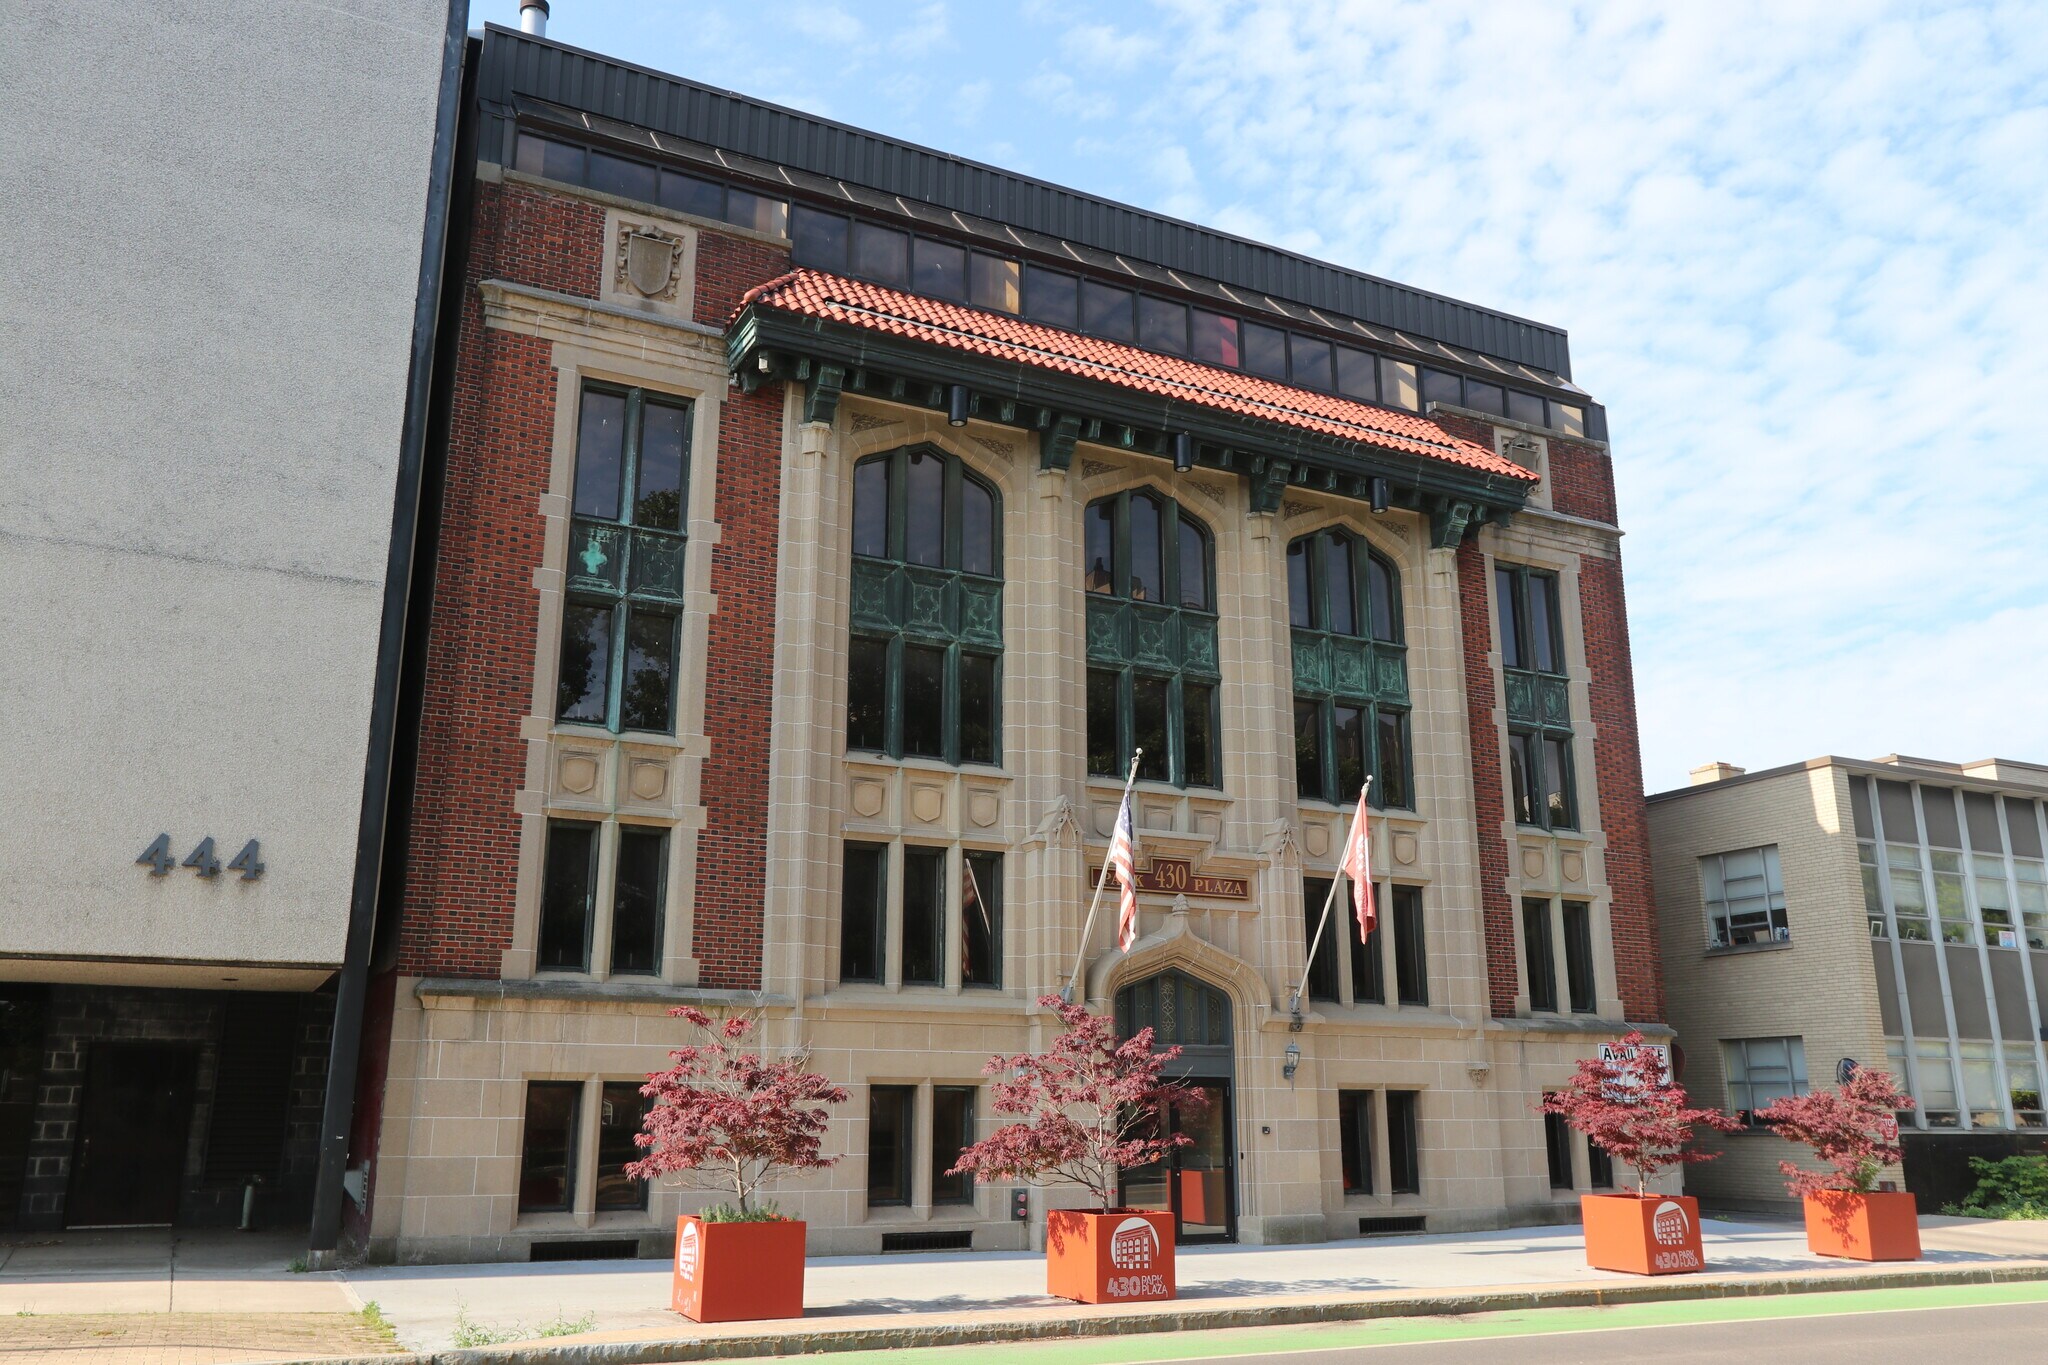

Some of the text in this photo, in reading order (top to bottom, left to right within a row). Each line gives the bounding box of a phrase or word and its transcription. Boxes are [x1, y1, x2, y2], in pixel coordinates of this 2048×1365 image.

[135, 832, 265, 879] 444
[1103, 863, 1244, 895] PAK 430 PLAZA
[1655, 1252, 1679, 1269] 430
[1679, 1250, 1695, 1259] PARK
[1107, 1275, 1140, 1297] 430
[1142, 1275, 1163, 1285] PARK
[1142, 1284, 1168, 1297] PLAZA
